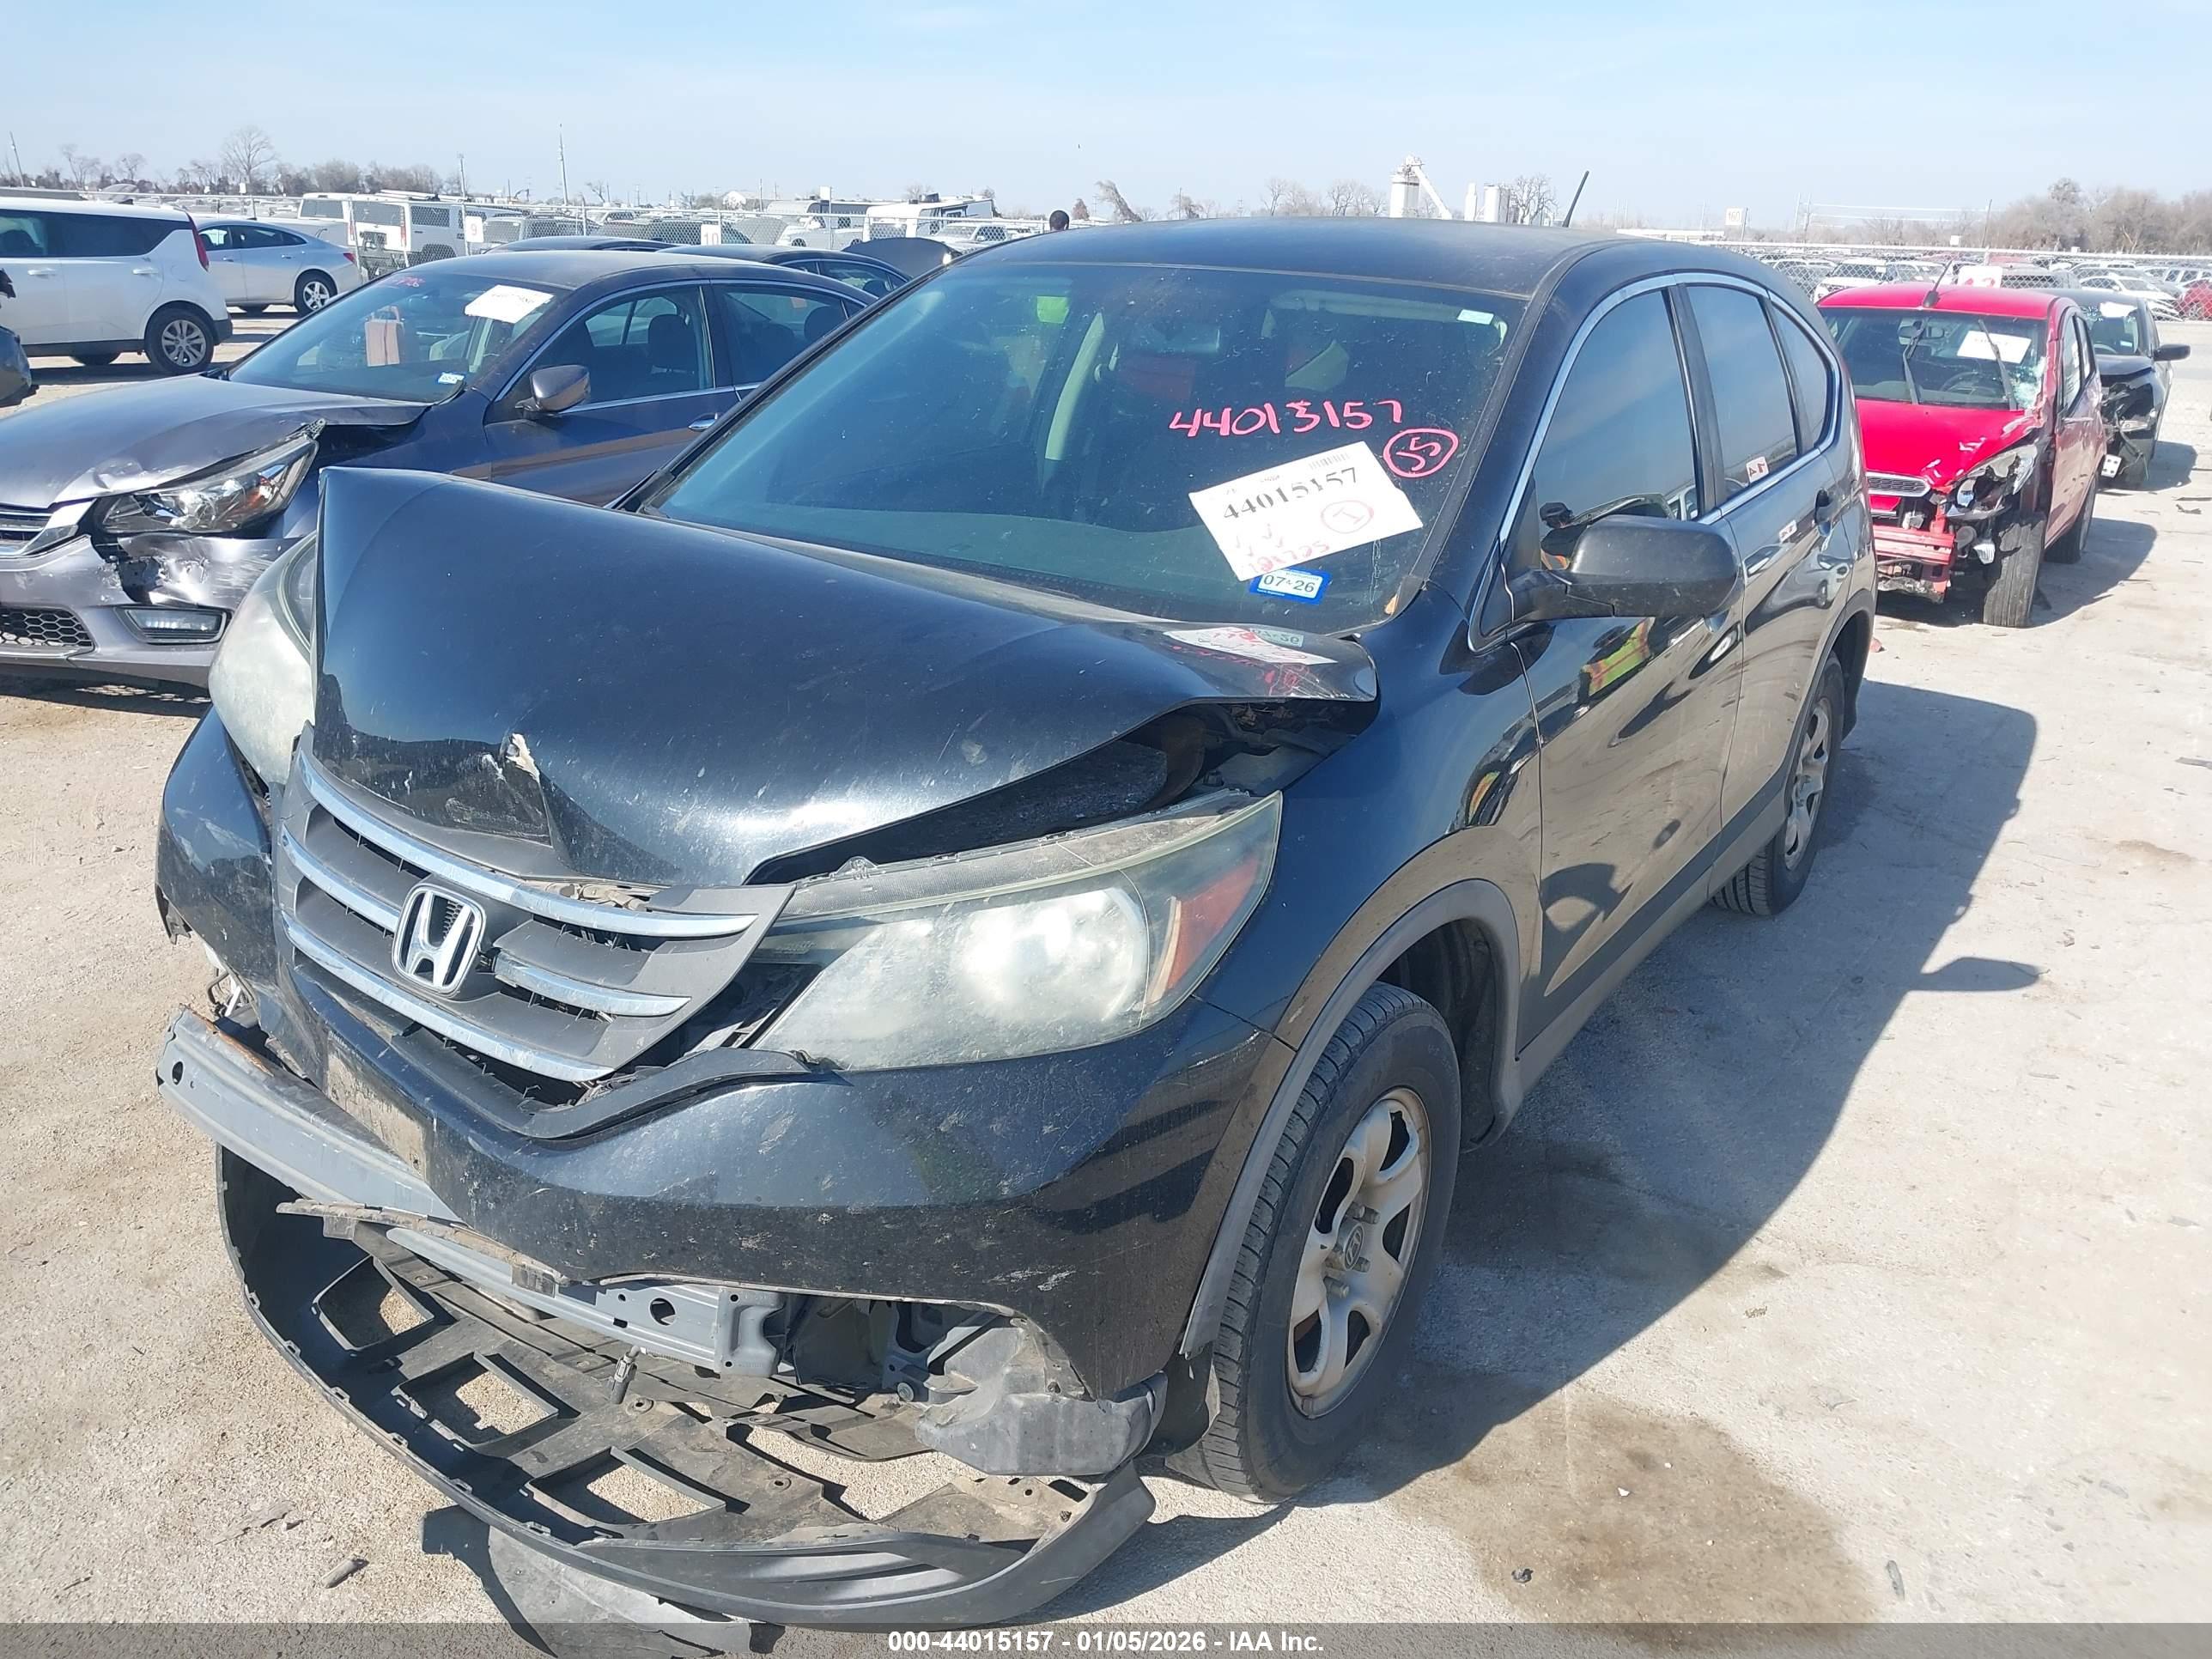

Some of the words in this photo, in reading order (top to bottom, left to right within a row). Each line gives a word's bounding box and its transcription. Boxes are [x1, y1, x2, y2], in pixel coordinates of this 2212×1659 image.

[471, 223, 477, 235] 9
[1223, 466, 1357, 519] 44015157
[1263, 574, 1286, 586] 07
[1292, 580, 1316, 592] 26
